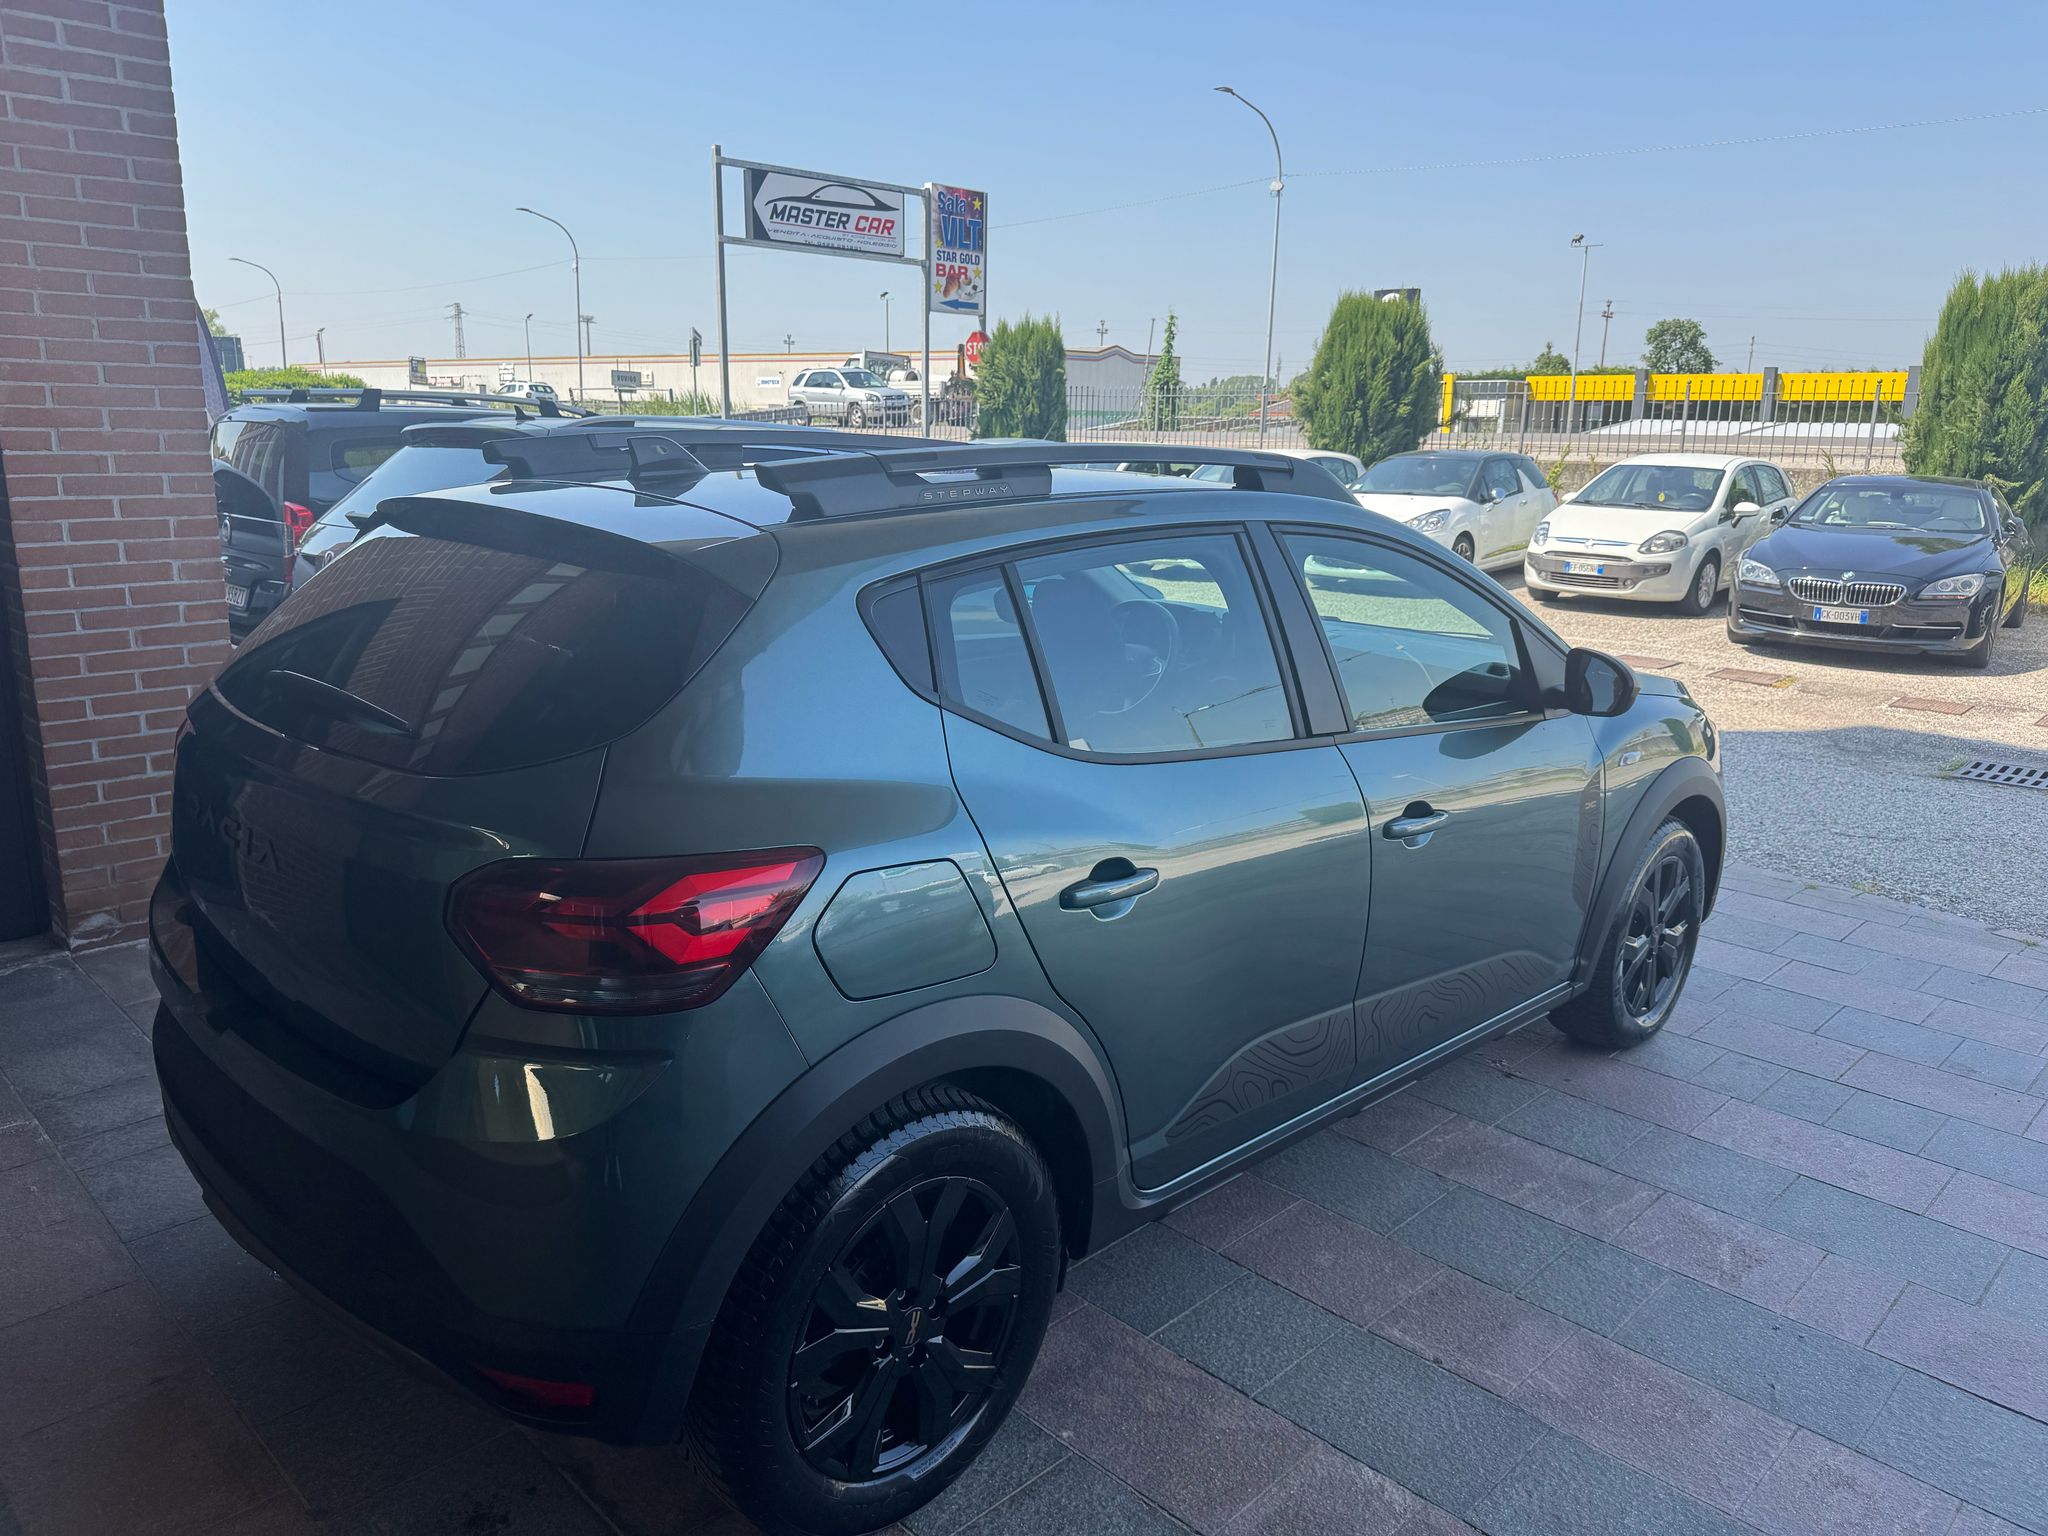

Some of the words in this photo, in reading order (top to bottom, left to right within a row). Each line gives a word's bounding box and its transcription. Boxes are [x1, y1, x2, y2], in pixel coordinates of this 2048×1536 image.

[937, 191, 967, 213] Sala
[769, 203, 851, 230] MASTER
[854, 215, 896, 236] CAR
[940, 214, 983, 251] VLT
[936, 249, 957, 263] STAR
[959, 252, 980, 266] GOLD
[935, 262, 968, 280] BAR
[923, 485, 1009, 500] STEPWAY
